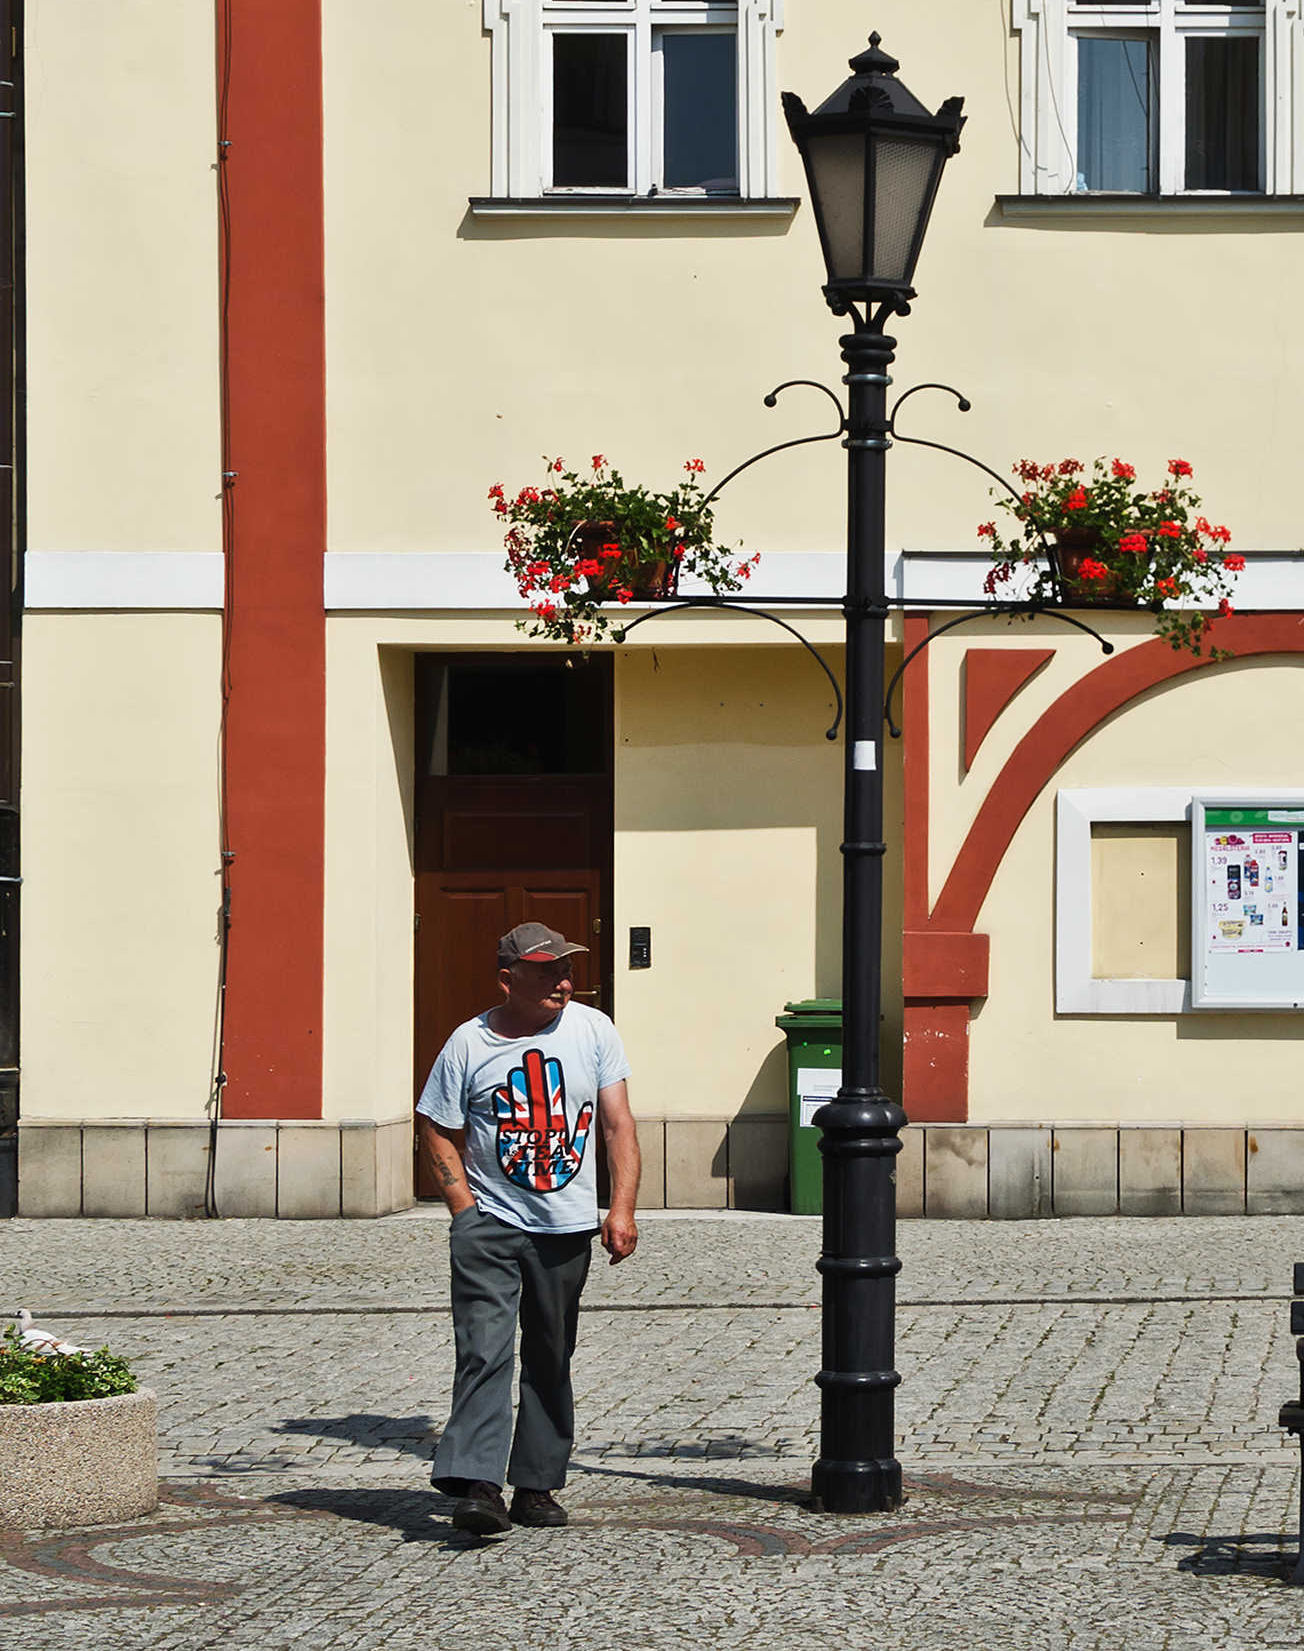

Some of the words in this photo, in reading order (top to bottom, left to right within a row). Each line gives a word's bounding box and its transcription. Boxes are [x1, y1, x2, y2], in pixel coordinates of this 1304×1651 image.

[1212, 903, 1228, 911] 1,25
[500, 1129, 566, 1144] STOP!
[518, 1145, 566, 1160] TEA
[509, 1159, 575, 1176] TIME
